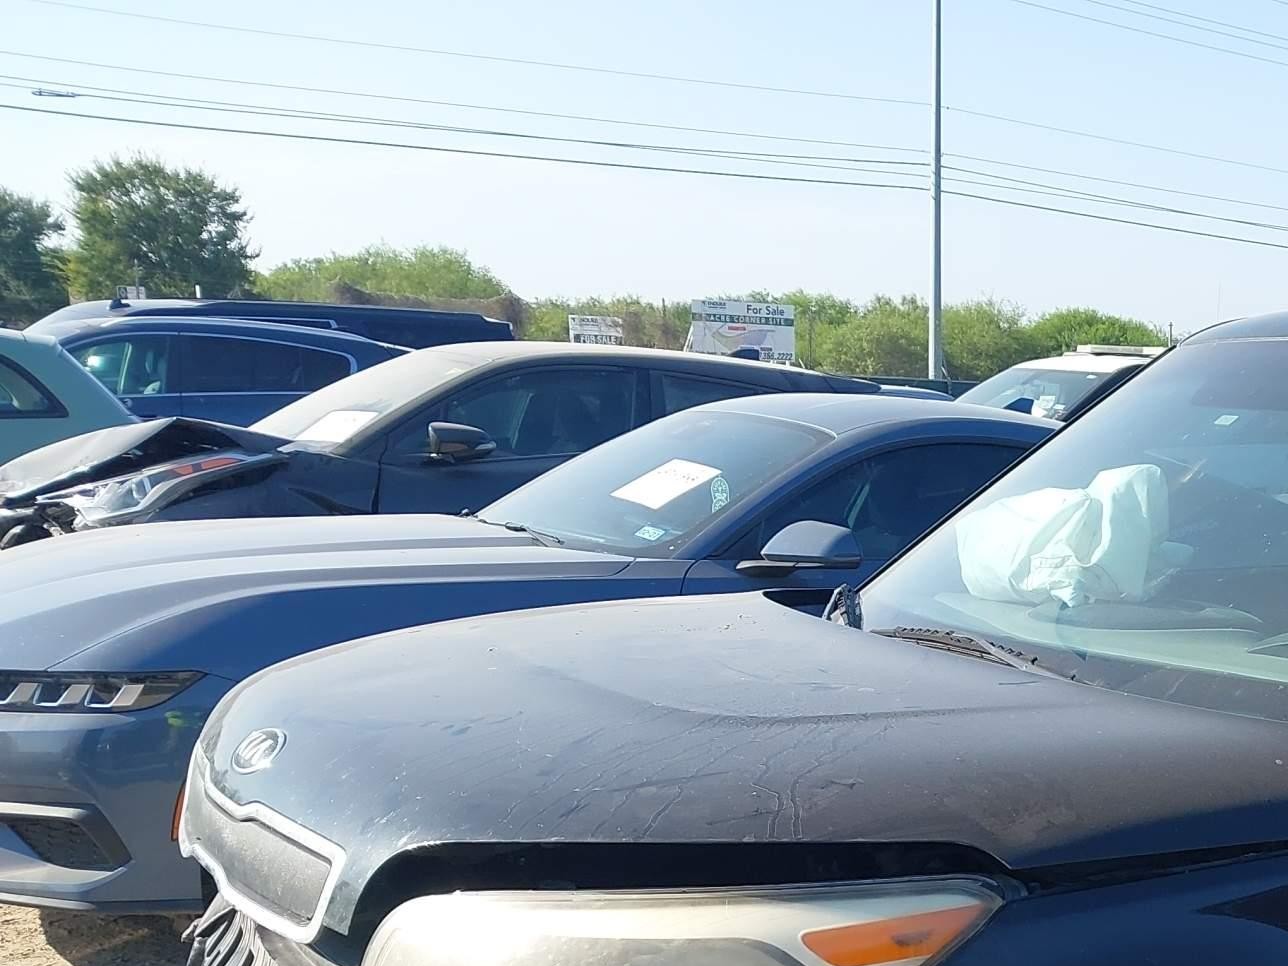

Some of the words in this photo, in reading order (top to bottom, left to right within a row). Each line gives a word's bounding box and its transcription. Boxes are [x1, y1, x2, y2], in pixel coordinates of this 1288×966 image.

[746, 304, 763, 314] For
[765, 305, 785, 316] Sale
[734, 315, 765, 324] CORNER
[580, 335, 596, 344] FOR
[597, 335, 617, 345] SALE
